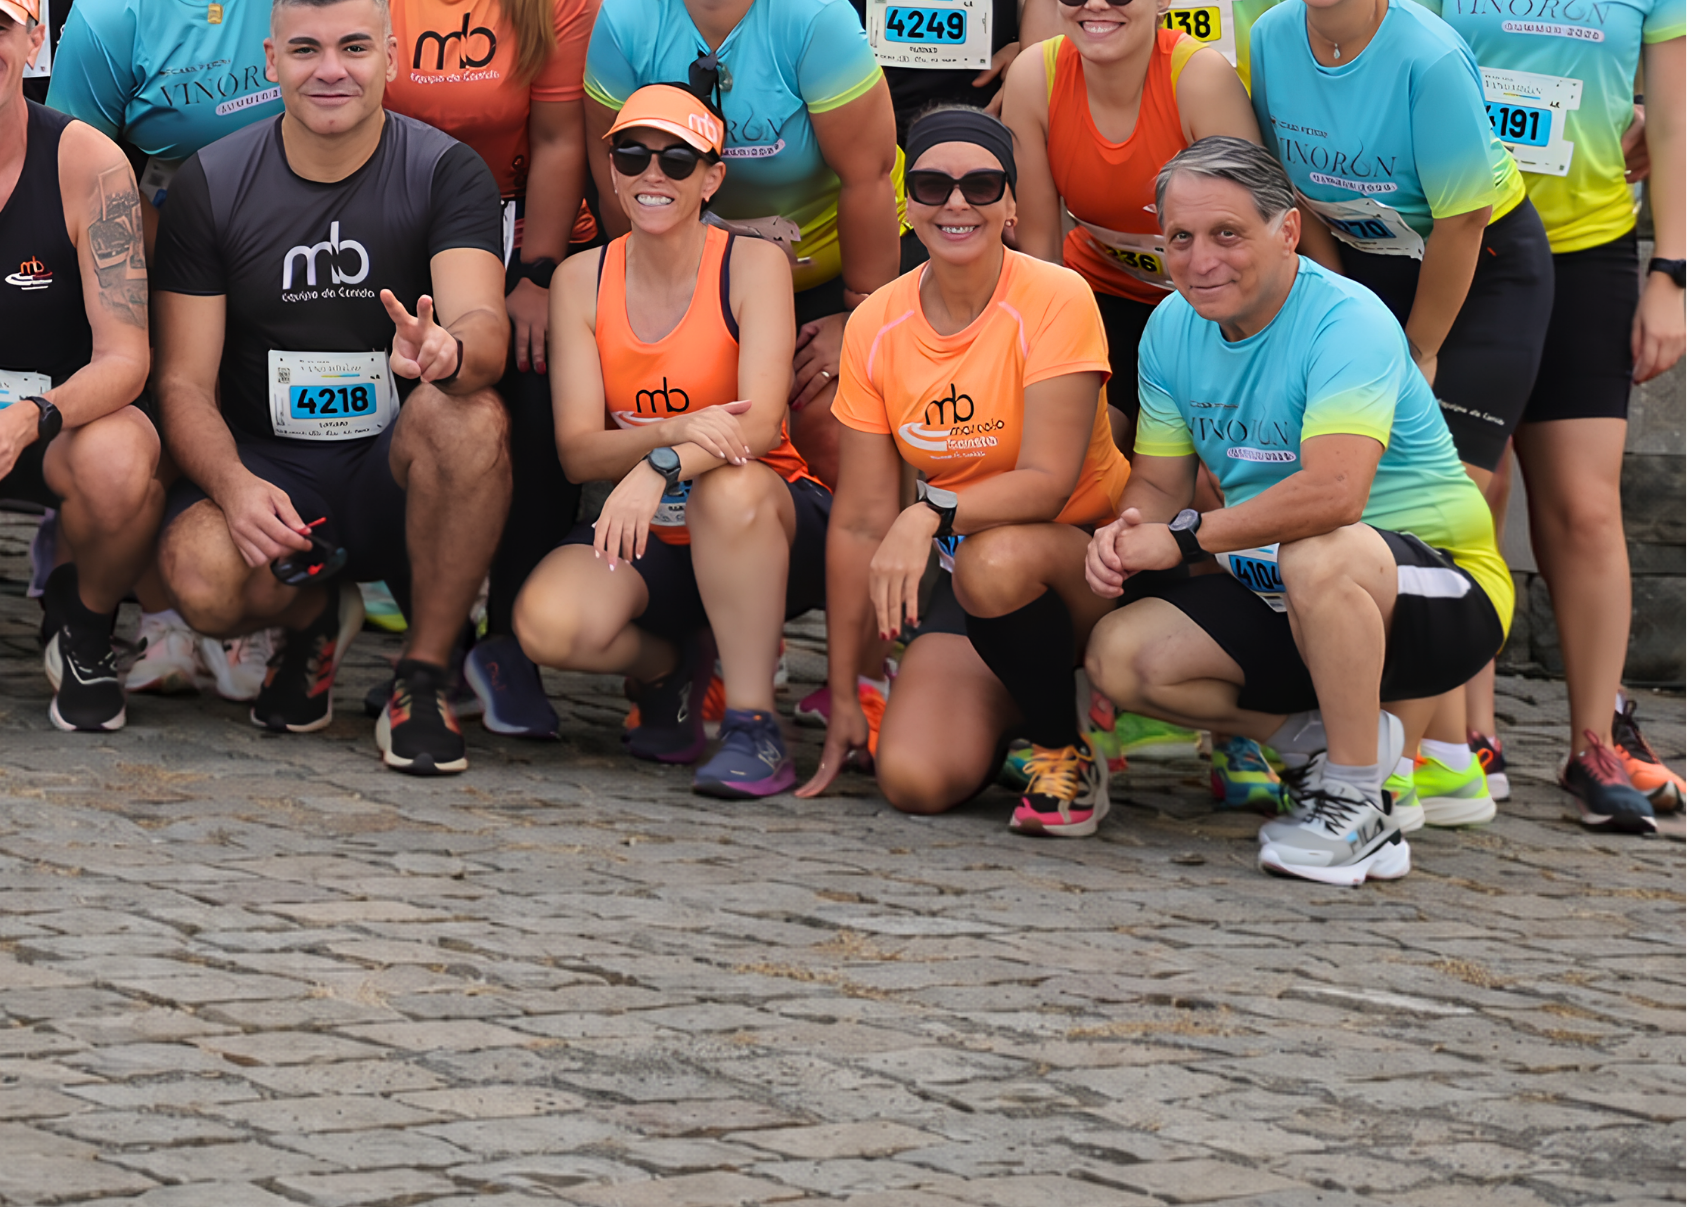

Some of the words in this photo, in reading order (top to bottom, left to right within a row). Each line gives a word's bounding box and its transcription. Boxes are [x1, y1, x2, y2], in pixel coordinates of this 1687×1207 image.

[412, 11, 497, 70] mb
[886, 8, 965, 40] 4249
[1279, 137, 1398, 179] INORUN
[282, 220, 371, 290] mb
[296, 385, 370, 415] 4218
[635, 376, 690, 414] mb
[924, 382, 975, 426] mb
